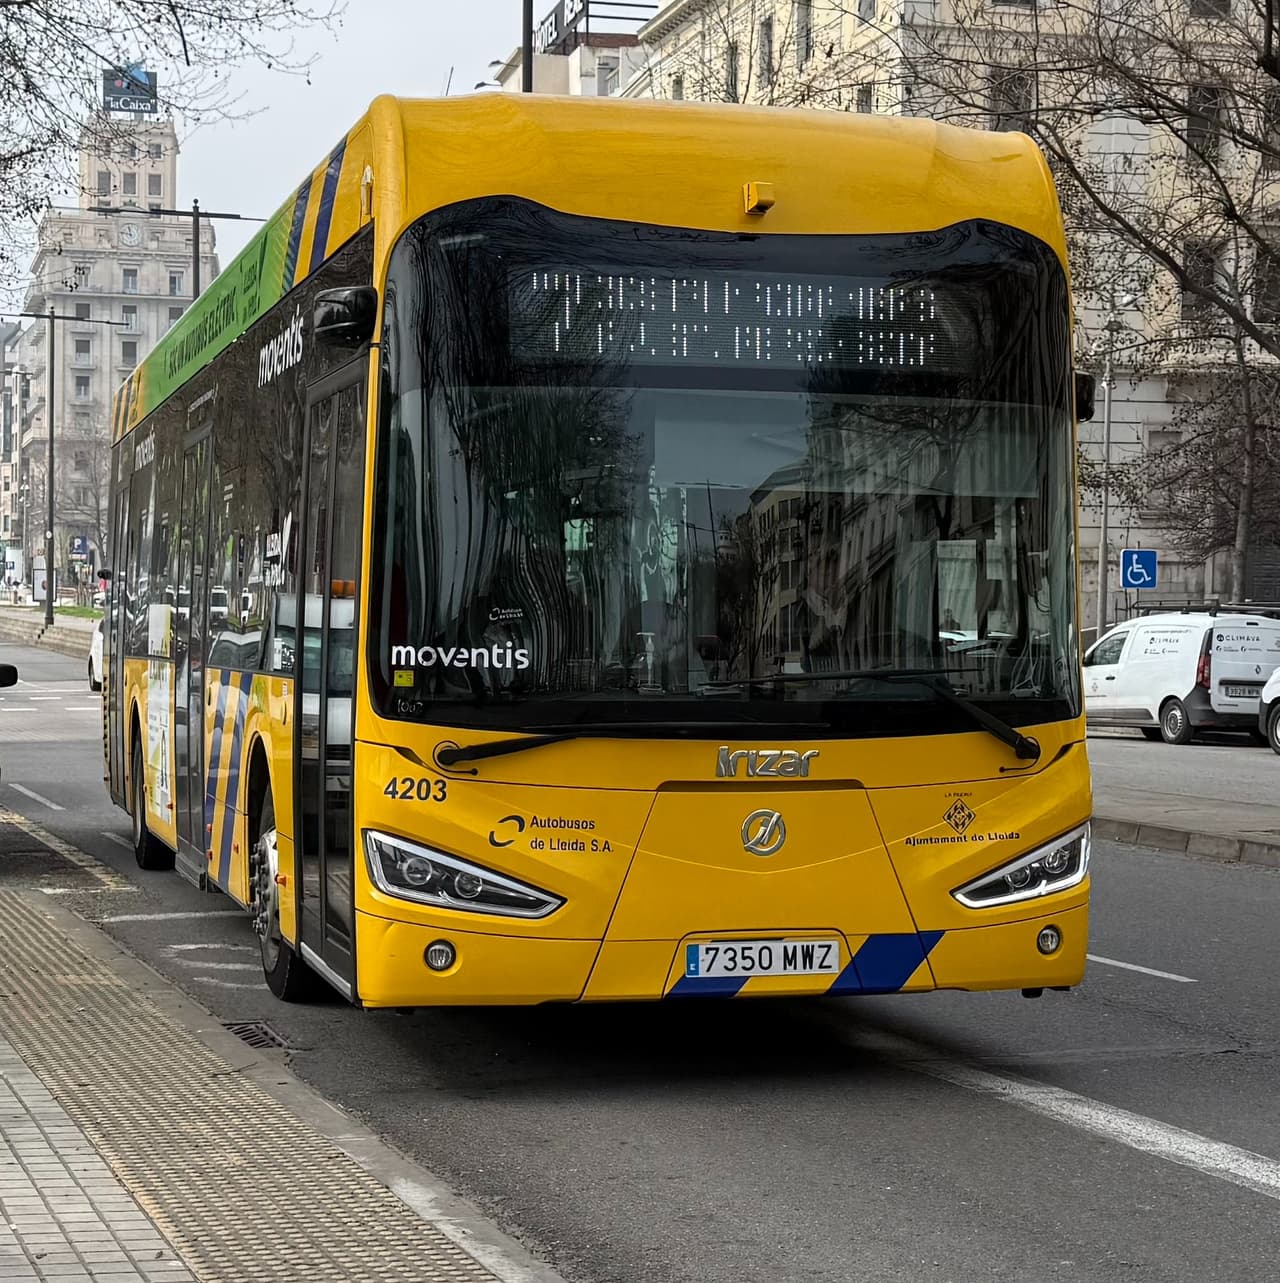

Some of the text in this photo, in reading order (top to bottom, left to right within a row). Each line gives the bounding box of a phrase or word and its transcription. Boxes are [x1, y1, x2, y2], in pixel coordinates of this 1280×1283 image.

[532, 13, 557, 54] HOTEL
[258, 303, 304, 389] moventis
[391, 640, 530, 670] moventis
[383, 777, 448, 802] 4203
[530, 816, 596, 830] Autobusos
[530, 837, 614, 853] de Lleida S.A.
[971, 834, 985, 843] de
[988, 832, 1021, 842] Lleida
[705, 946, 774, 973] 7350
[783, 944, 833, 971] MWZ
